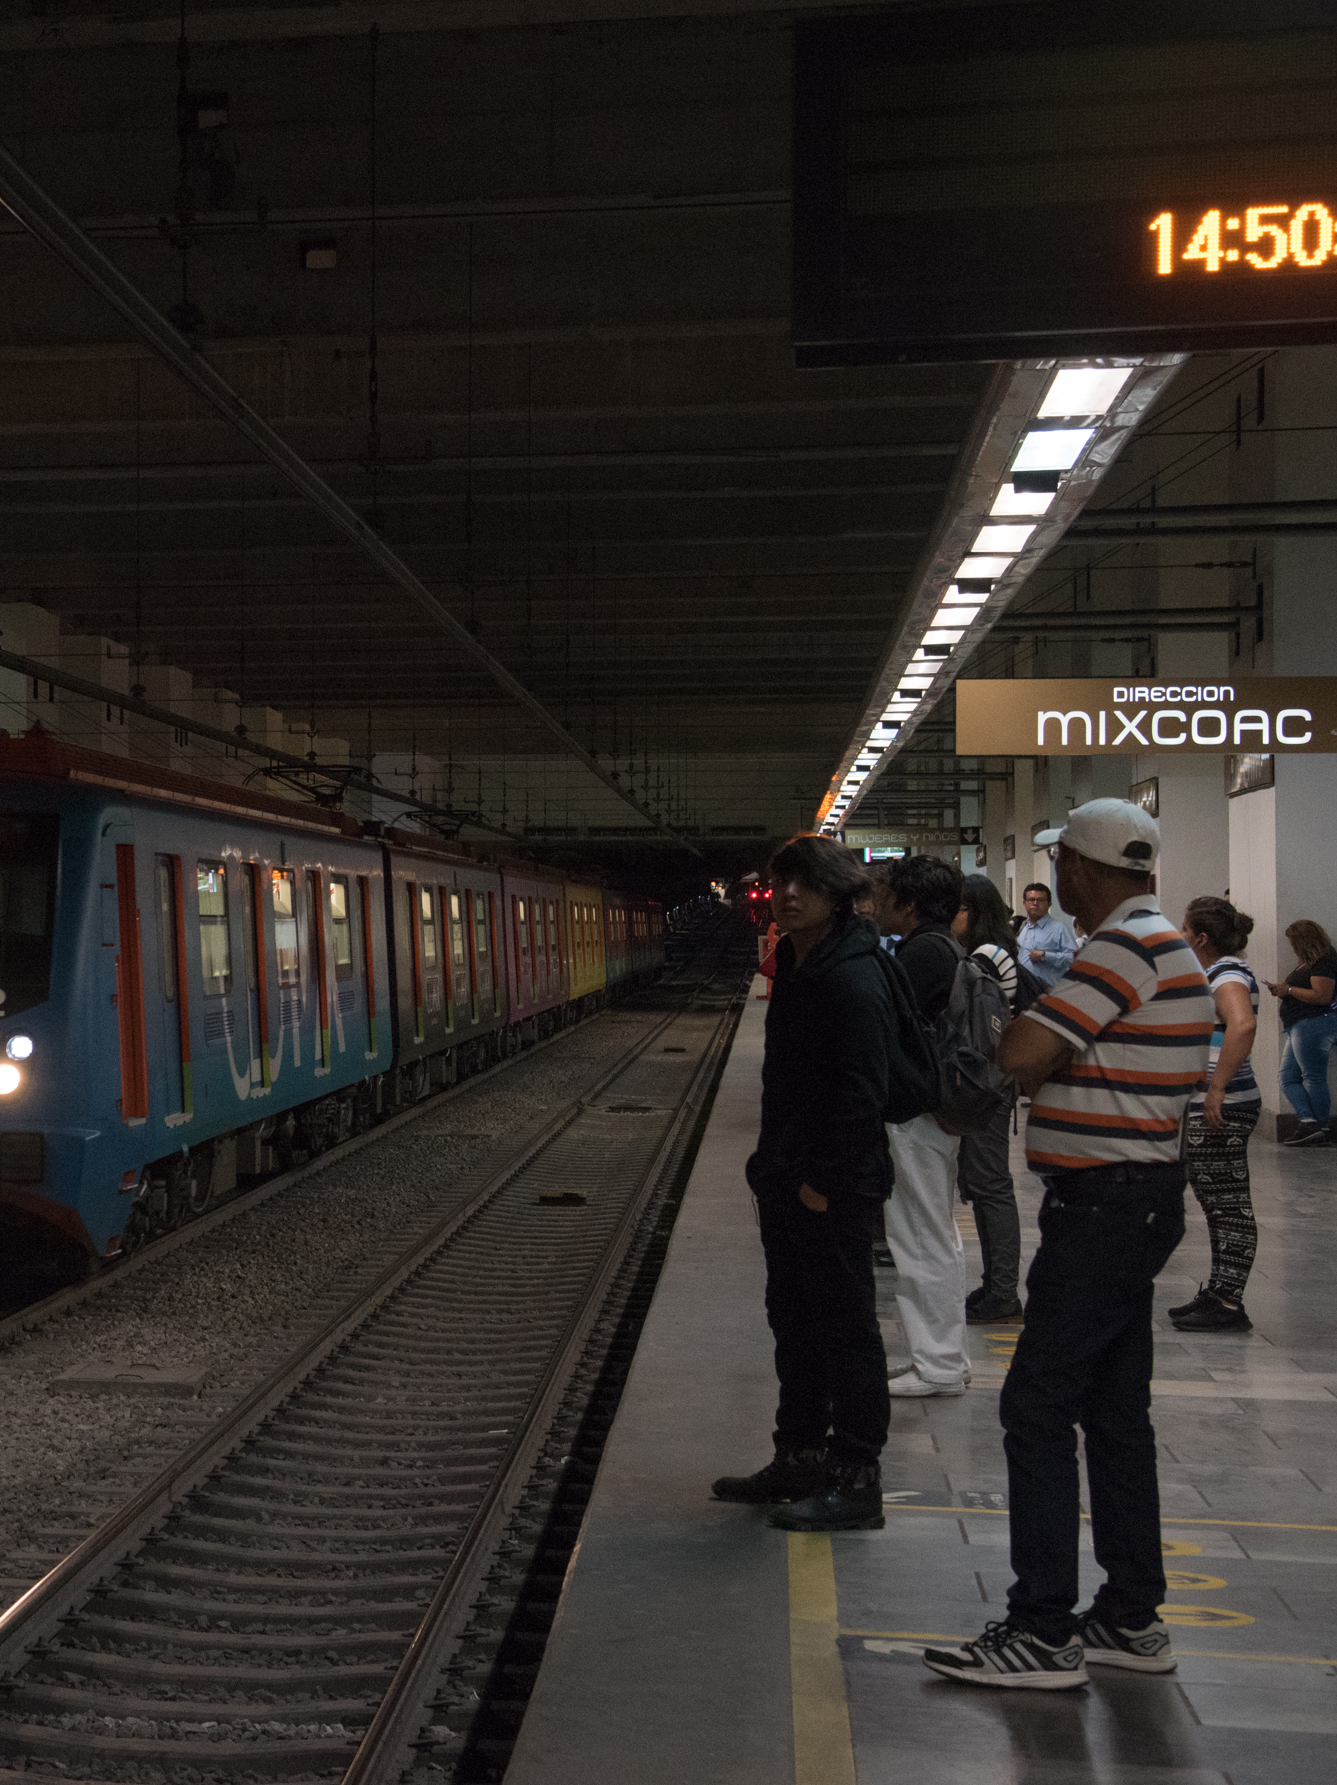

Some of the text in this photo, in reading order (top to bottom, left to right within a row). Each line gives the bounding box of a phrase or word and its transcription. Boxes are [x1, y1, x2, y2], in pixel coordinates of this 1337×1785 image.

[1113, 686, 1235, 703] DIRECCION
[1037, 708, 1313, 746] MIXCOAC
[847, 833, 908, 844] MUJERES
[911, 833, 919, 842] Y
